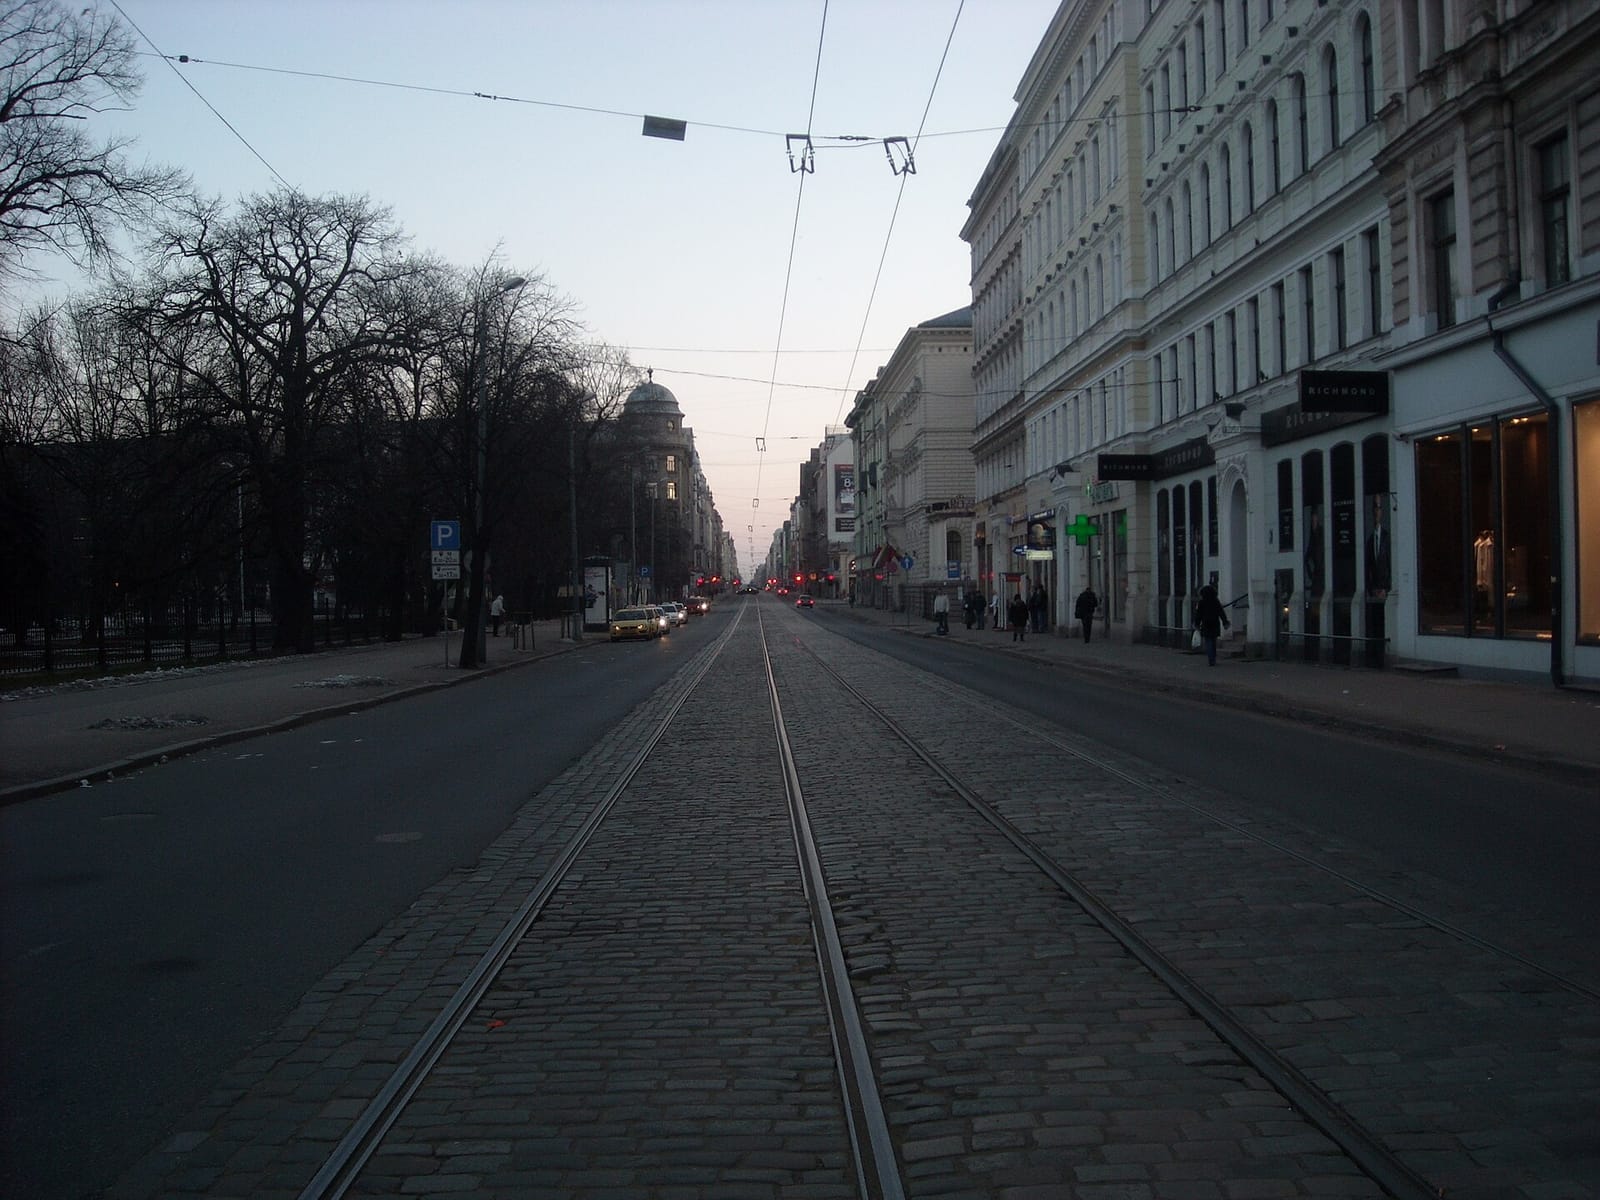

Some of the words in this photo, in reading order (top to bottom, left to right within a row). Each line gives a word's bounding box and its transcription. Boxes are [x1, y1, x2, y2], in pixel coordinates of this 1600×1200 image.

[1307, 386, 1376, 397] RICHMOND
[437, 524, 453, 547] P
[641, 567, 648, 576] P
